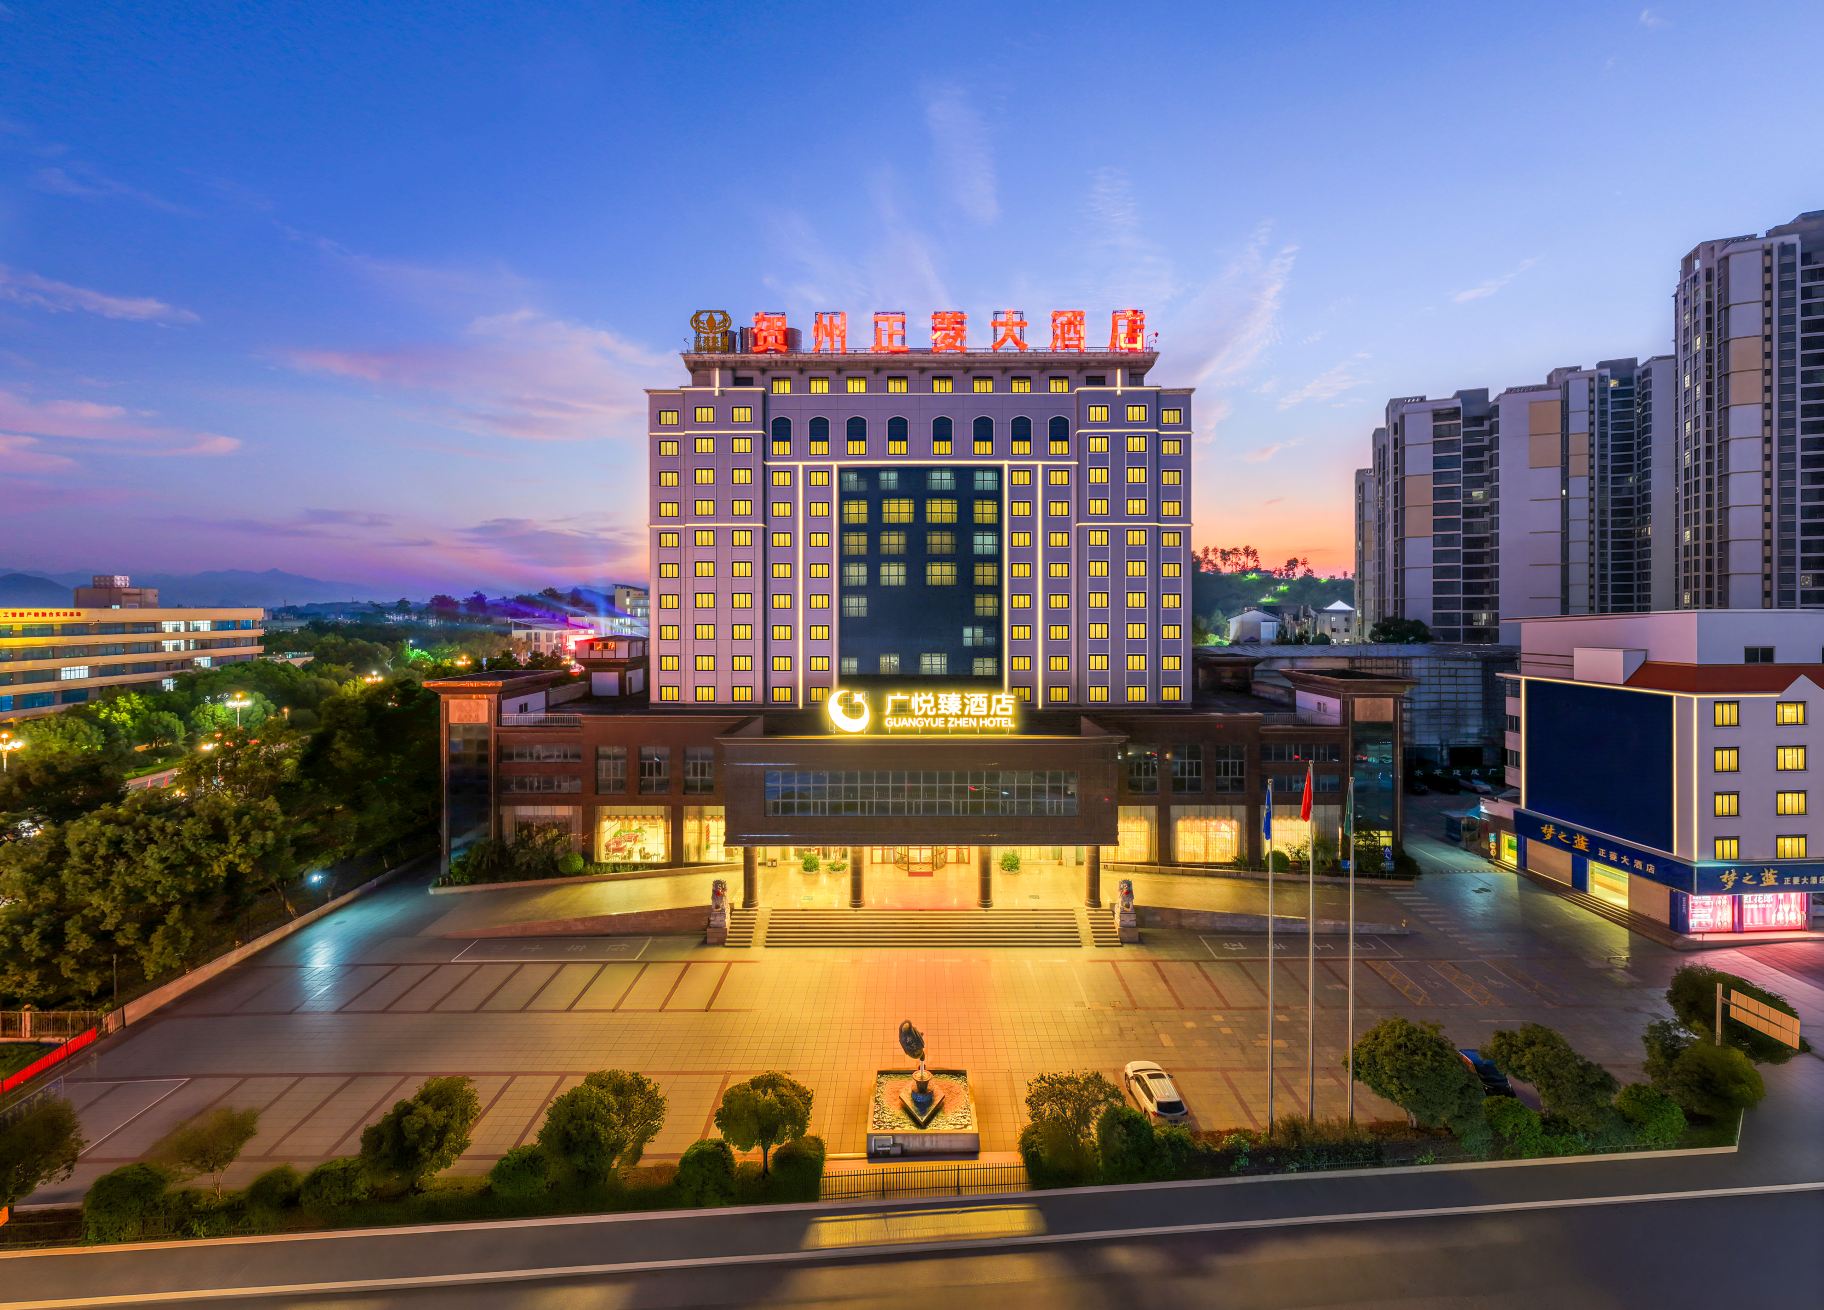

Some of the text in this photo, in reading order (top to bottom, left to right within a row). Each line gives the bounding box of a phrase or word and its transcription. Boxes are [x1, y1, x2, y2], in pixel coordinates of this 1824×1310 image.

[752, 309, 1146, 354] 贺州正菱大酒店
[885, 692, 1016, 716] 广悦臻酒店
[885, 718, 1015, 728] GUANGYUE ZHEN HOTEL
[1540, 824, 1590, 852] 梦之蓝
[1719, 867, 1779, 891] 梦之蓝
